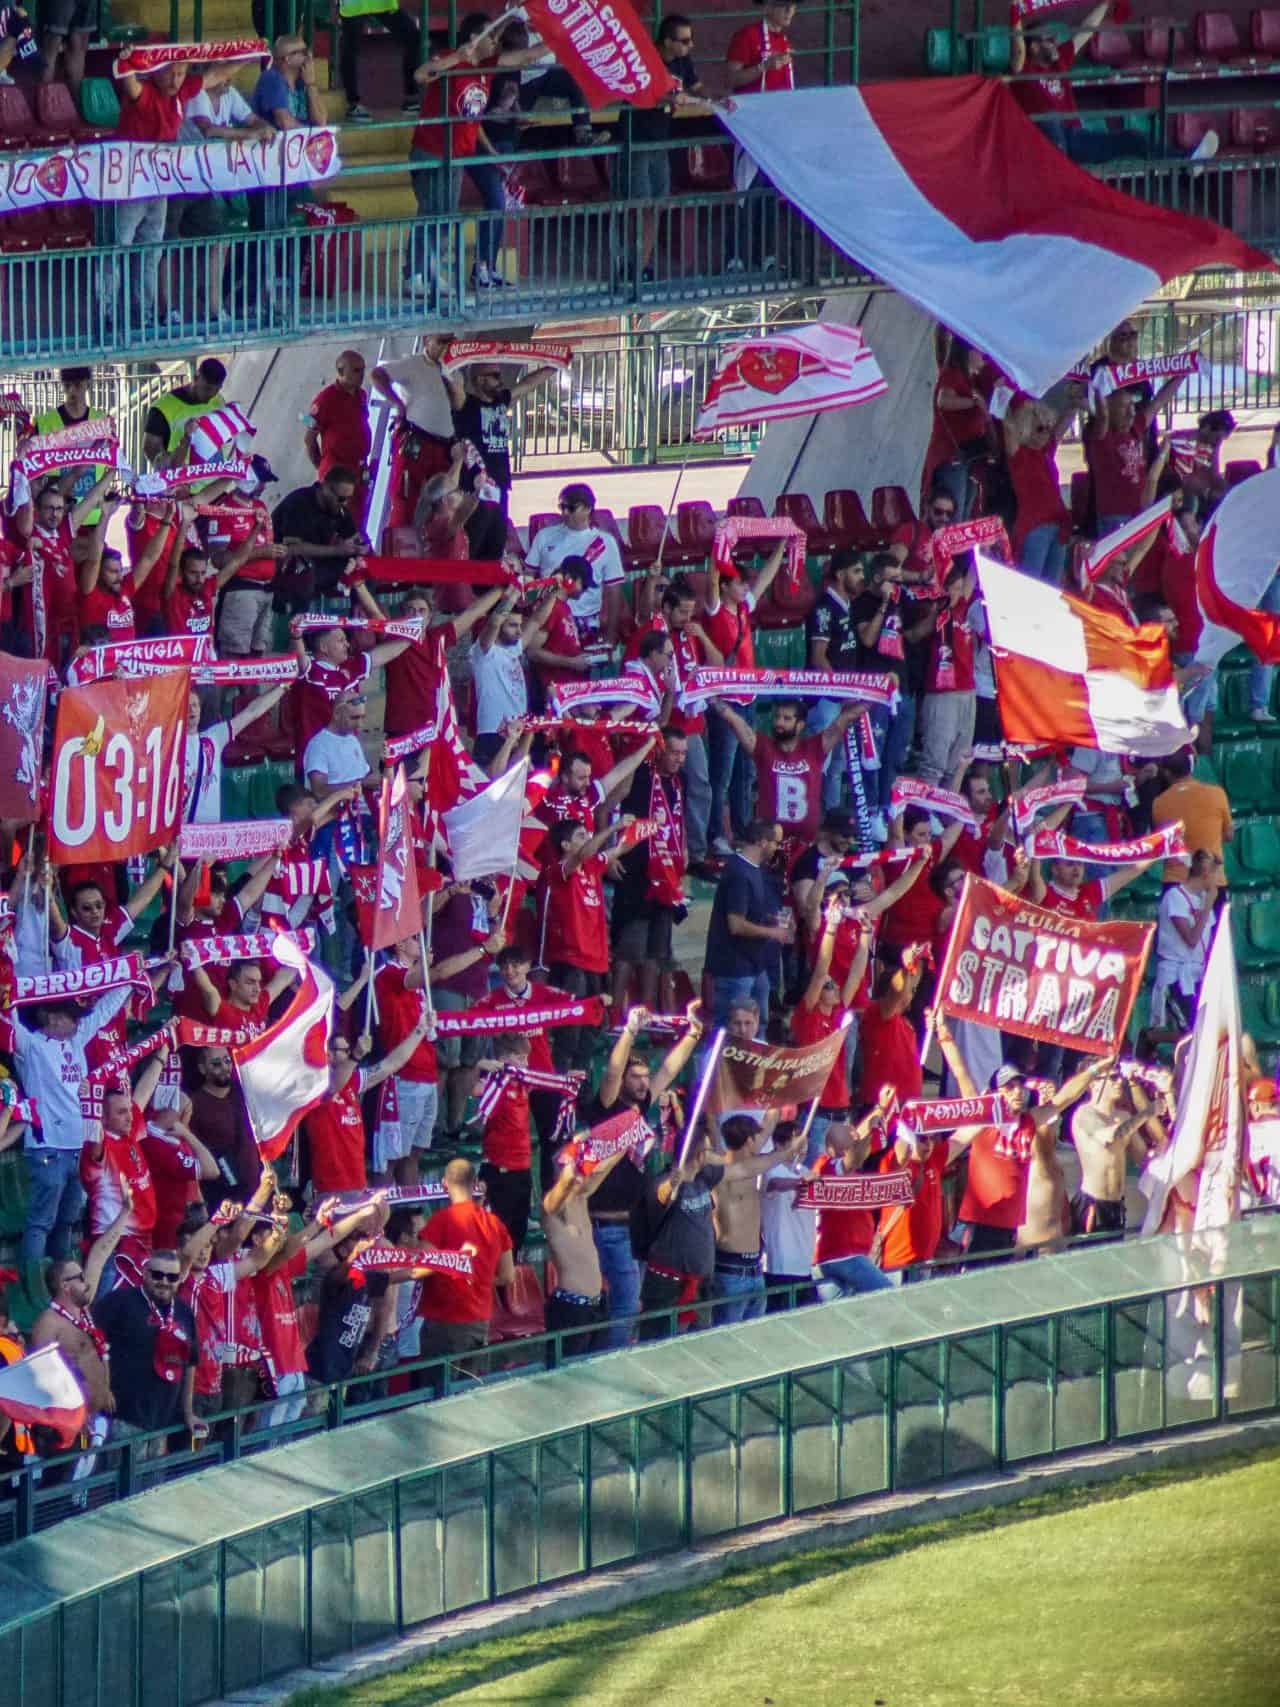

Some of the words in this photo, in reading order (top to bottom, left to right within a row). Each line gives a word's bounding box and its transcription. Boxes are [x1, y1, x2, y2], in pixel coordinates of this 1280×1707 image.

[597, 3, 651, 89] CATTIVA
[75, 138, 301, 185] SBAGLIATO
[1117, 363, 1135, 382] AC
[1137, 352, 1193, 378] PERUGIA
[23, 453, 44, 474] AC
[166, 468, 180, 480] AC
[696, 671, 737, 686] QUELLI
[789, 672, 829, 684] SANTA
[831, 673, 890, 689] GIULIANA
[776, 776, 808, 822] B
[1015, 910, 1081, 938] SULLA
[973, 915, 1125, 983] CATTIVA
[16, 956, 132, 997] PERUGIA
[949, 950, 1120, 1042] STRADA
